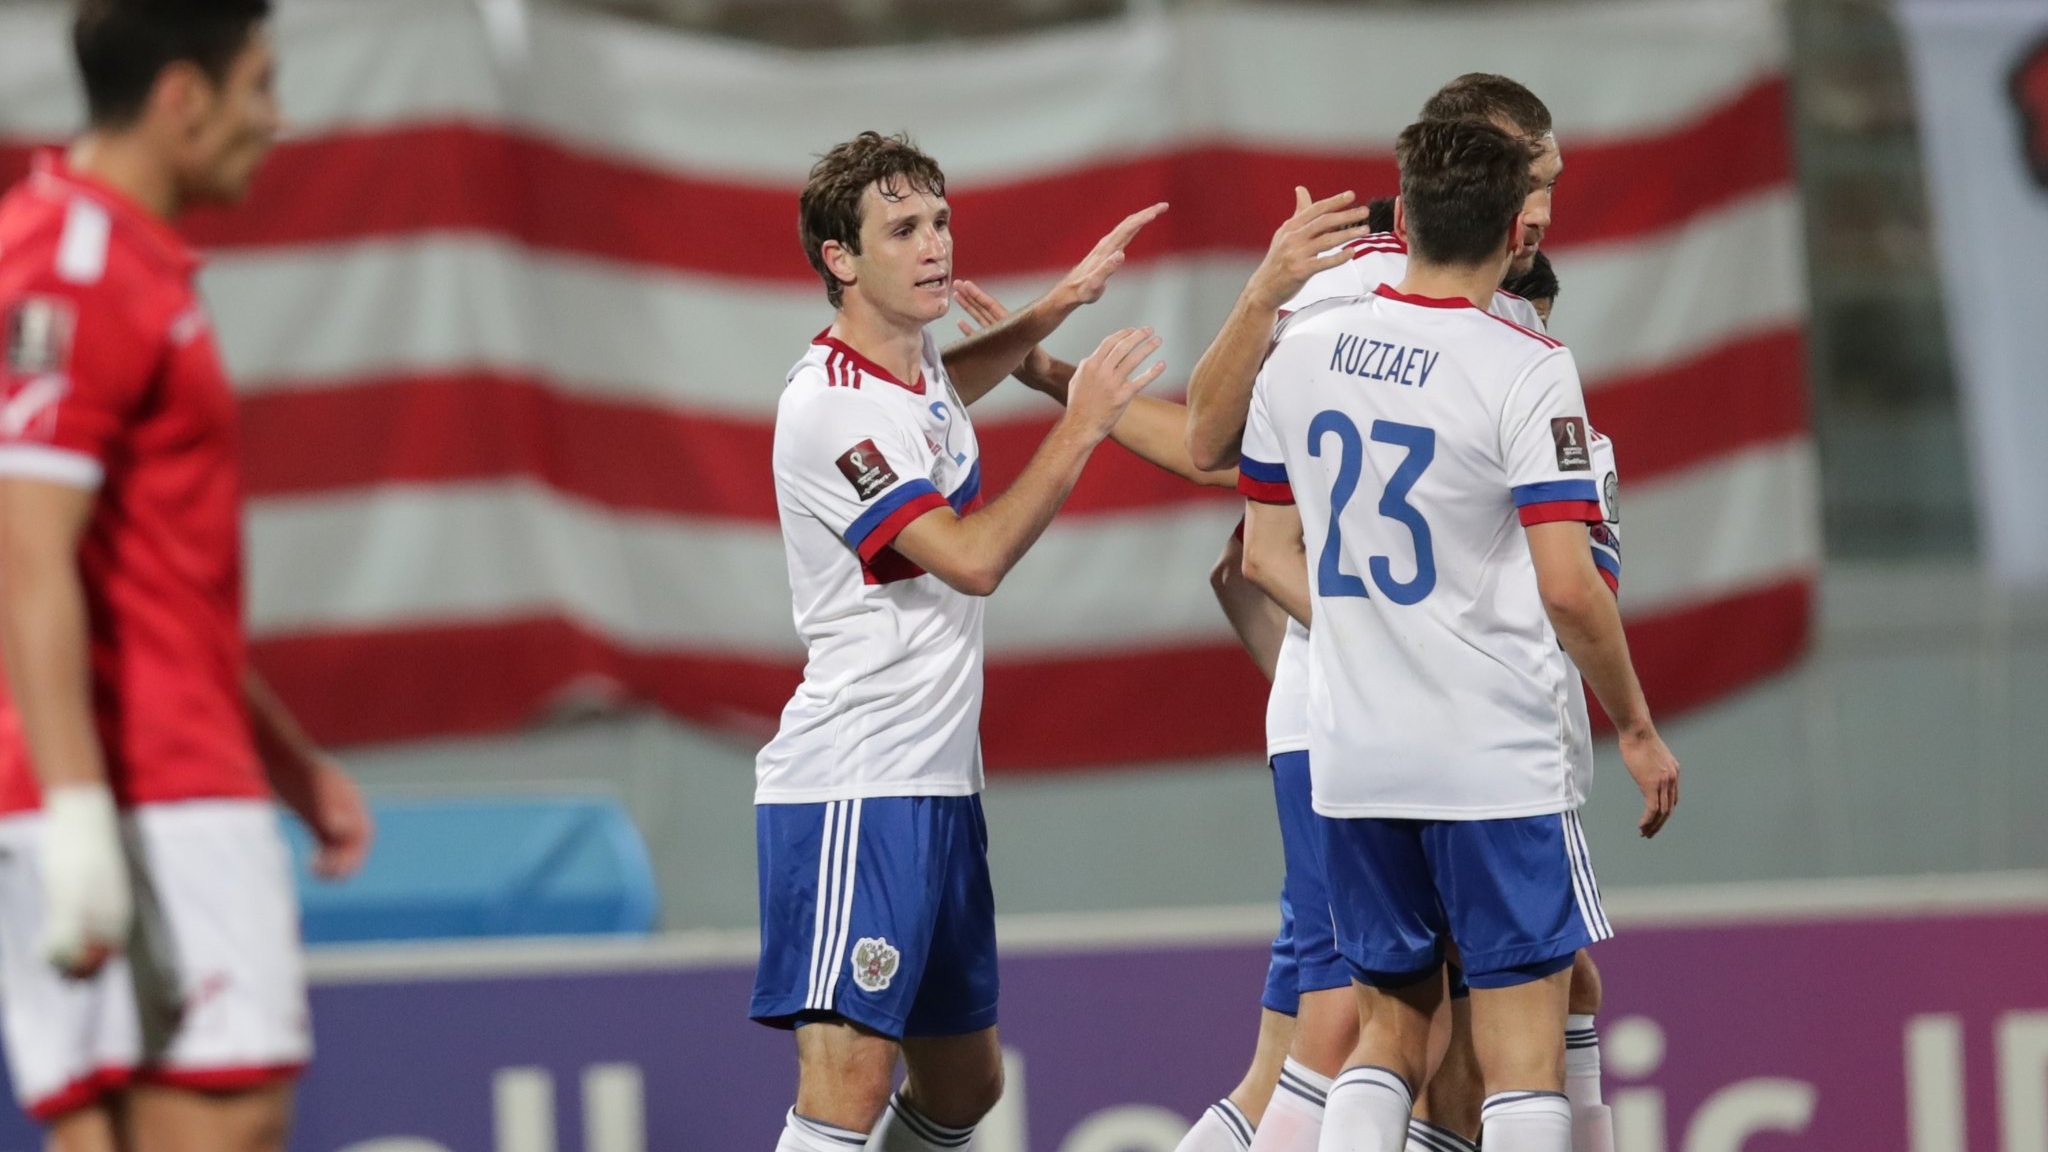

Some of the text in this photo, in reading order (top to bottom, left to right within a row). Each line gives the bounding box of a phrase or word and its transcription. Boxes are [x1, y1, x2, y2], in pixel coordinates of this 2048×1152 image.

[1329, 332, 1440, 388] KUZIAEV
[928, 400, 968, 468] 2
[1307, 409, 1437, 606] 23
